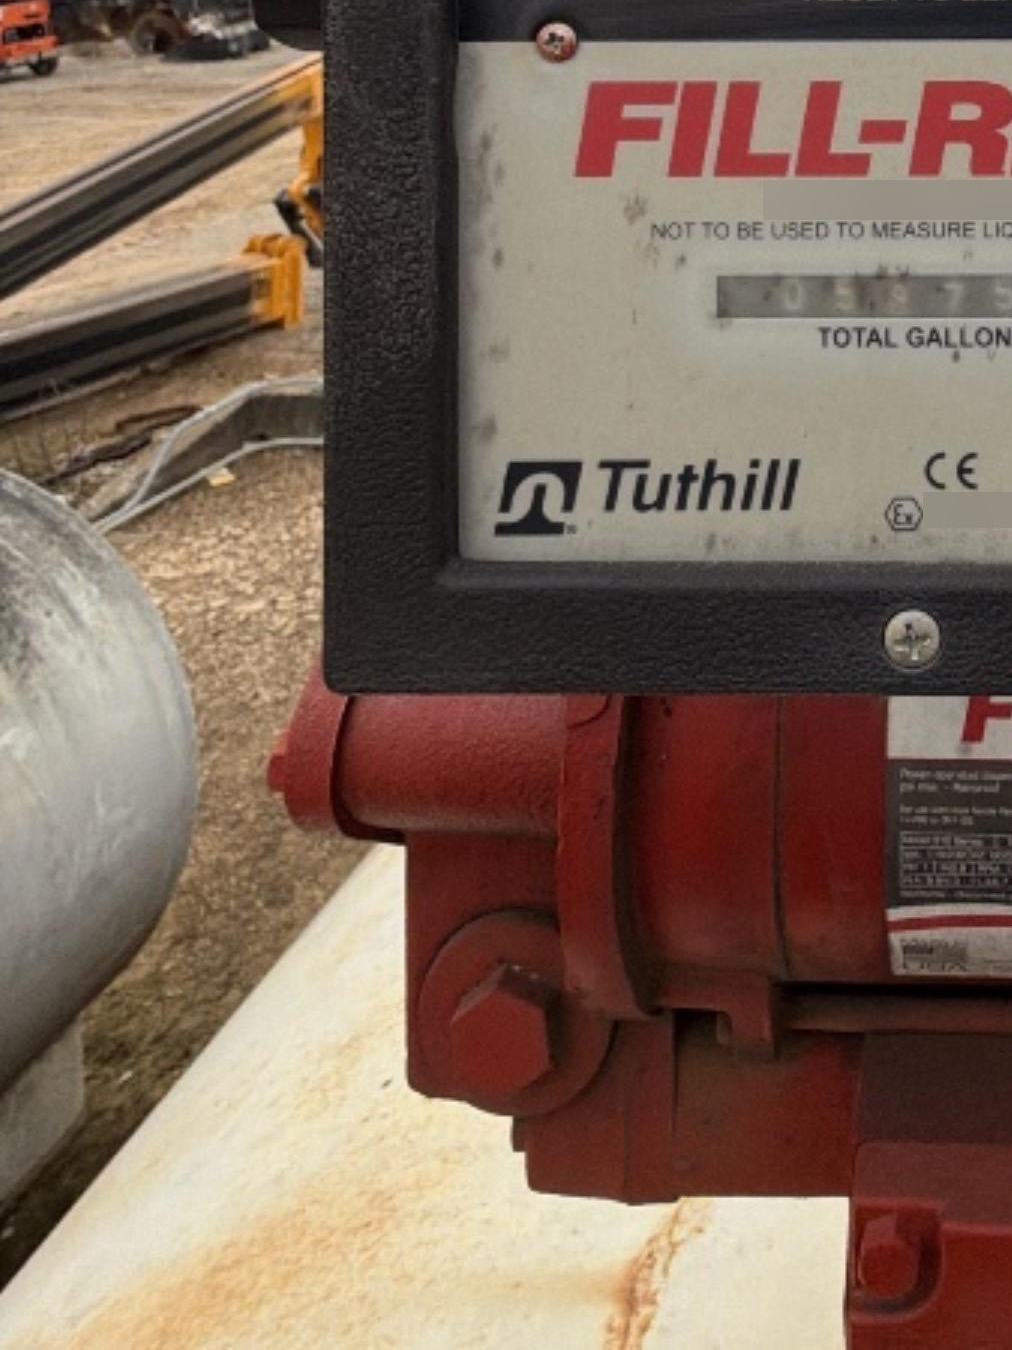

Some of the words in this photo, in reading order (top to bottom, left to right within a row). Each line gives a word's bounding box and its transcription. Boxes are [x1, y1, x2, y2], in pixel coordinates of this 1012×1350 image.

[650, 221, 697, 240] NOT
[702, 221, 731, 240] TO
[737, 221, 764, 240] BE
[770, 221, 830, 240] USED
[836, 221, 865, 240] TO
[872, 221, 976, 240] MEASURE
[817, 327, 898, 349] TOTAL
[597, 459, 800, 512] Tuthill
[924, 451, 978, 490] CE
